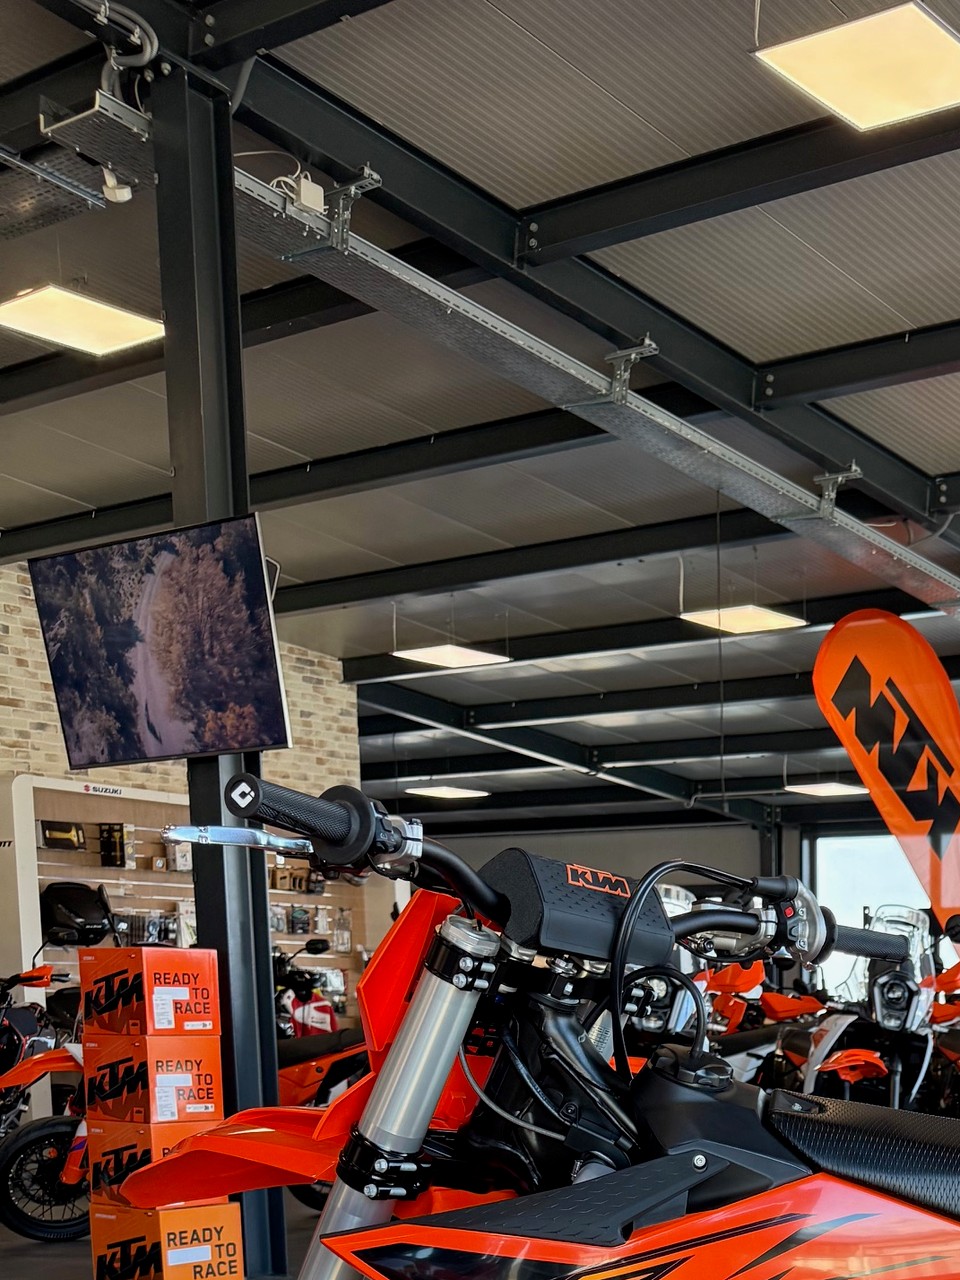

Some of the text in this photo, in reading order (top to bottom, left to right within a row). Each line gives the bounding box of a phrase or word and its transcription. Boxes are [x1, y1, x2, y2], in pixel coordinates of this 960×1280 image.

[92, 785, 122, 795] SUZUKI
[566, 864, 631, 898] KTM
[153, 972, 200, 985] READY
[84, 967, 143, 1021] KTM
[191, 987, 210, 1000] TO
[174, 1001, 211, 1014] RACE
[156, 1059, 203, 1072] READY
[87, 1055, 148, 1106] KTM
[194, 1073, 213, 1086] TO
[177, 1087, 214, 1100] RACE
[167, 1225, 225, 1247] READY
[214, 1242, 237, 1259] TO
[193, 1259, 238, 1280] RACE
